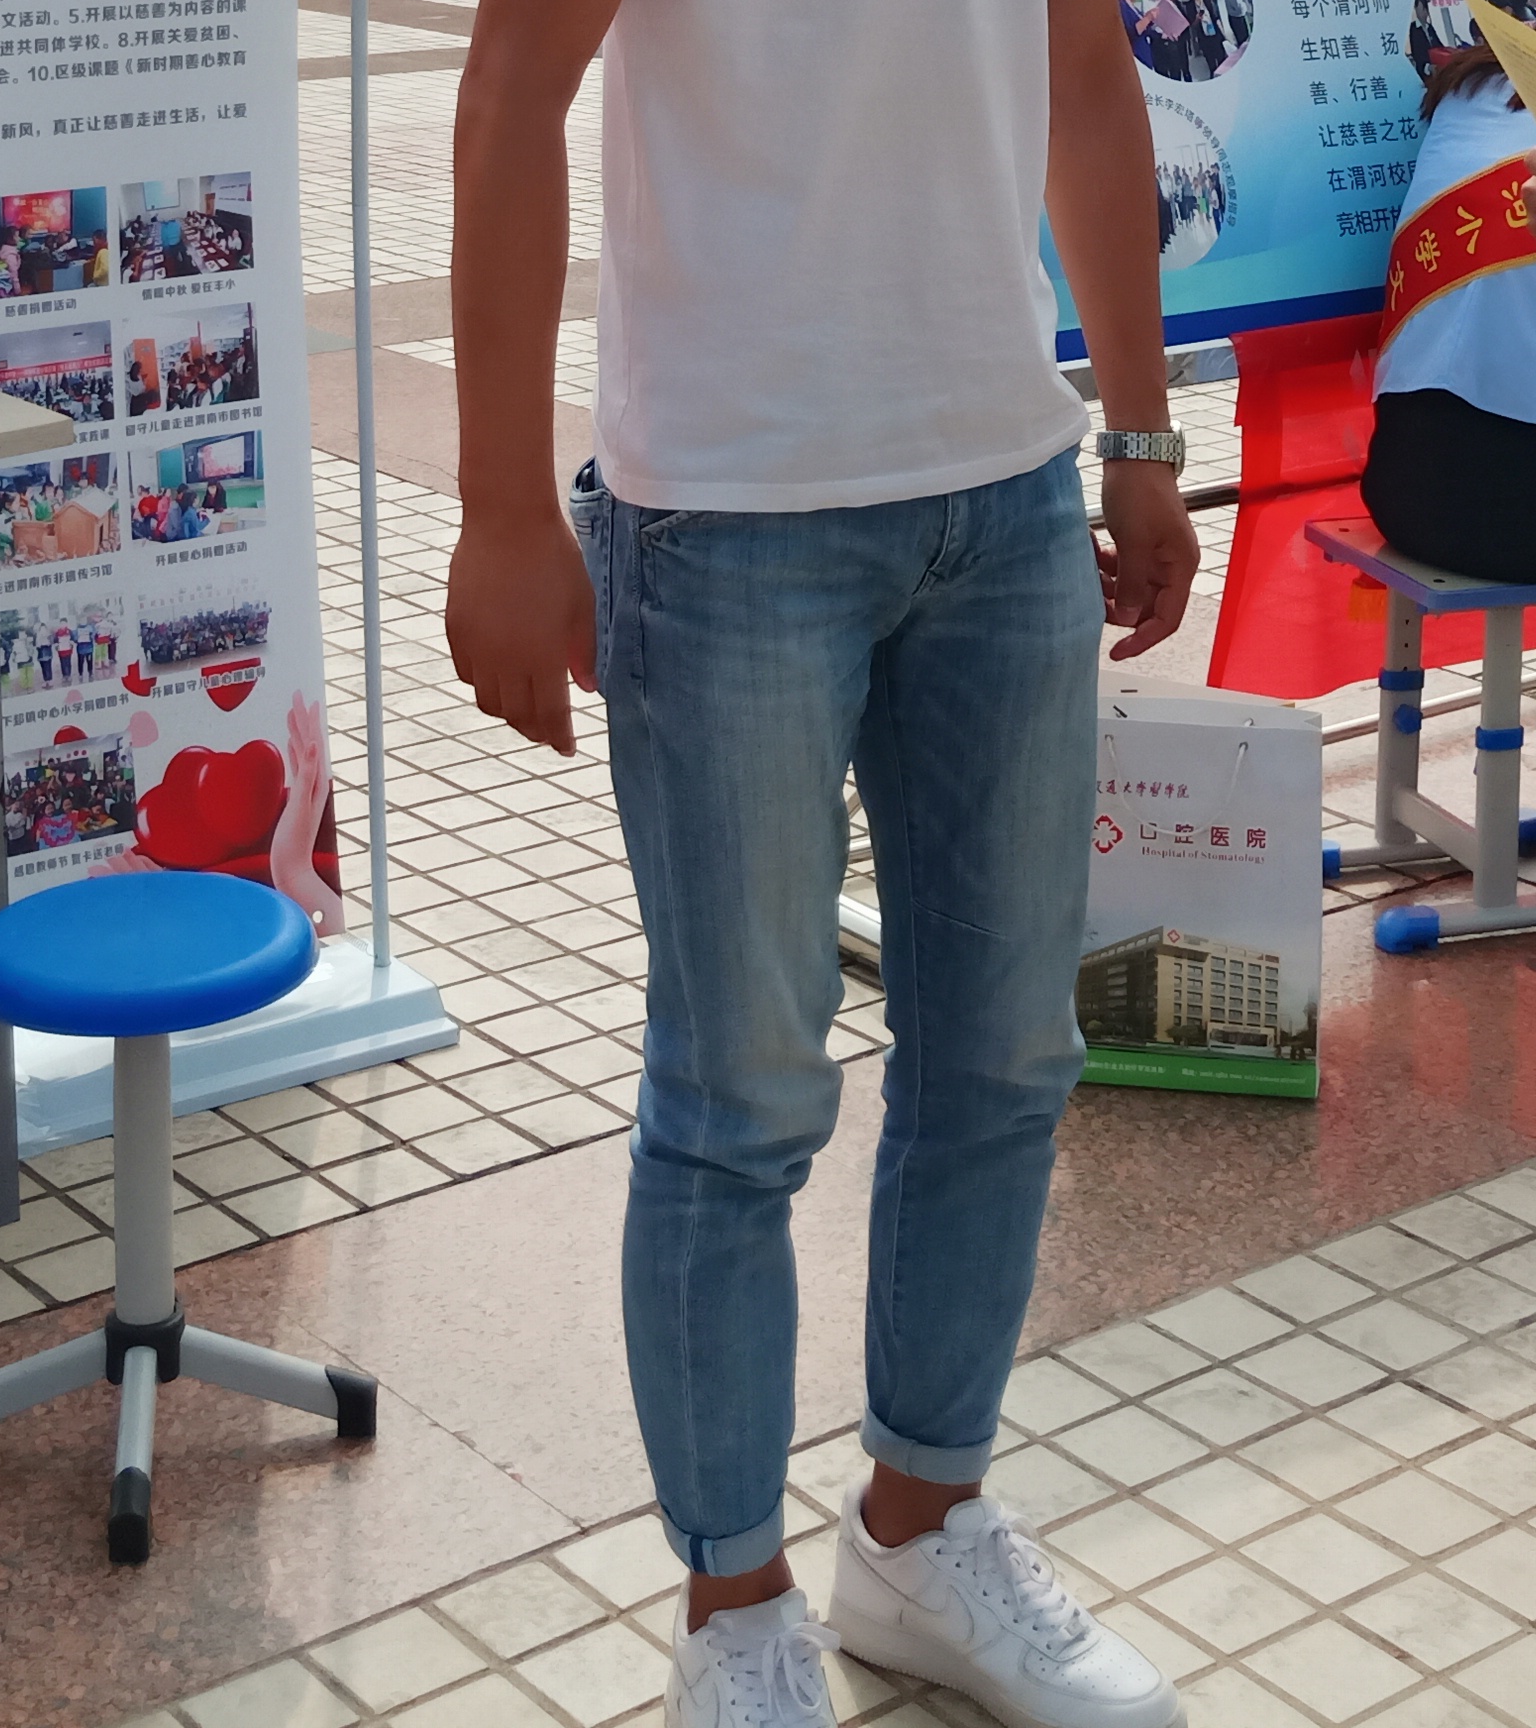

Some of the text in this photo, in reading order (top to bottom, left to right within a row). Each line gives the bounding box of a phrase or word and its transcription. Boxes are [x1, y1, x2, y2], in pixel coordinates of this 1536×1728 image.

[1300, 32, 1400, 62] 生知善、扬
[1319, 117, 1419, 149] 让慈善之花
[1140, 822, 1266, 849] 口腔医院
[1142, 846, 1265, 865] Hospital of Stomatology
